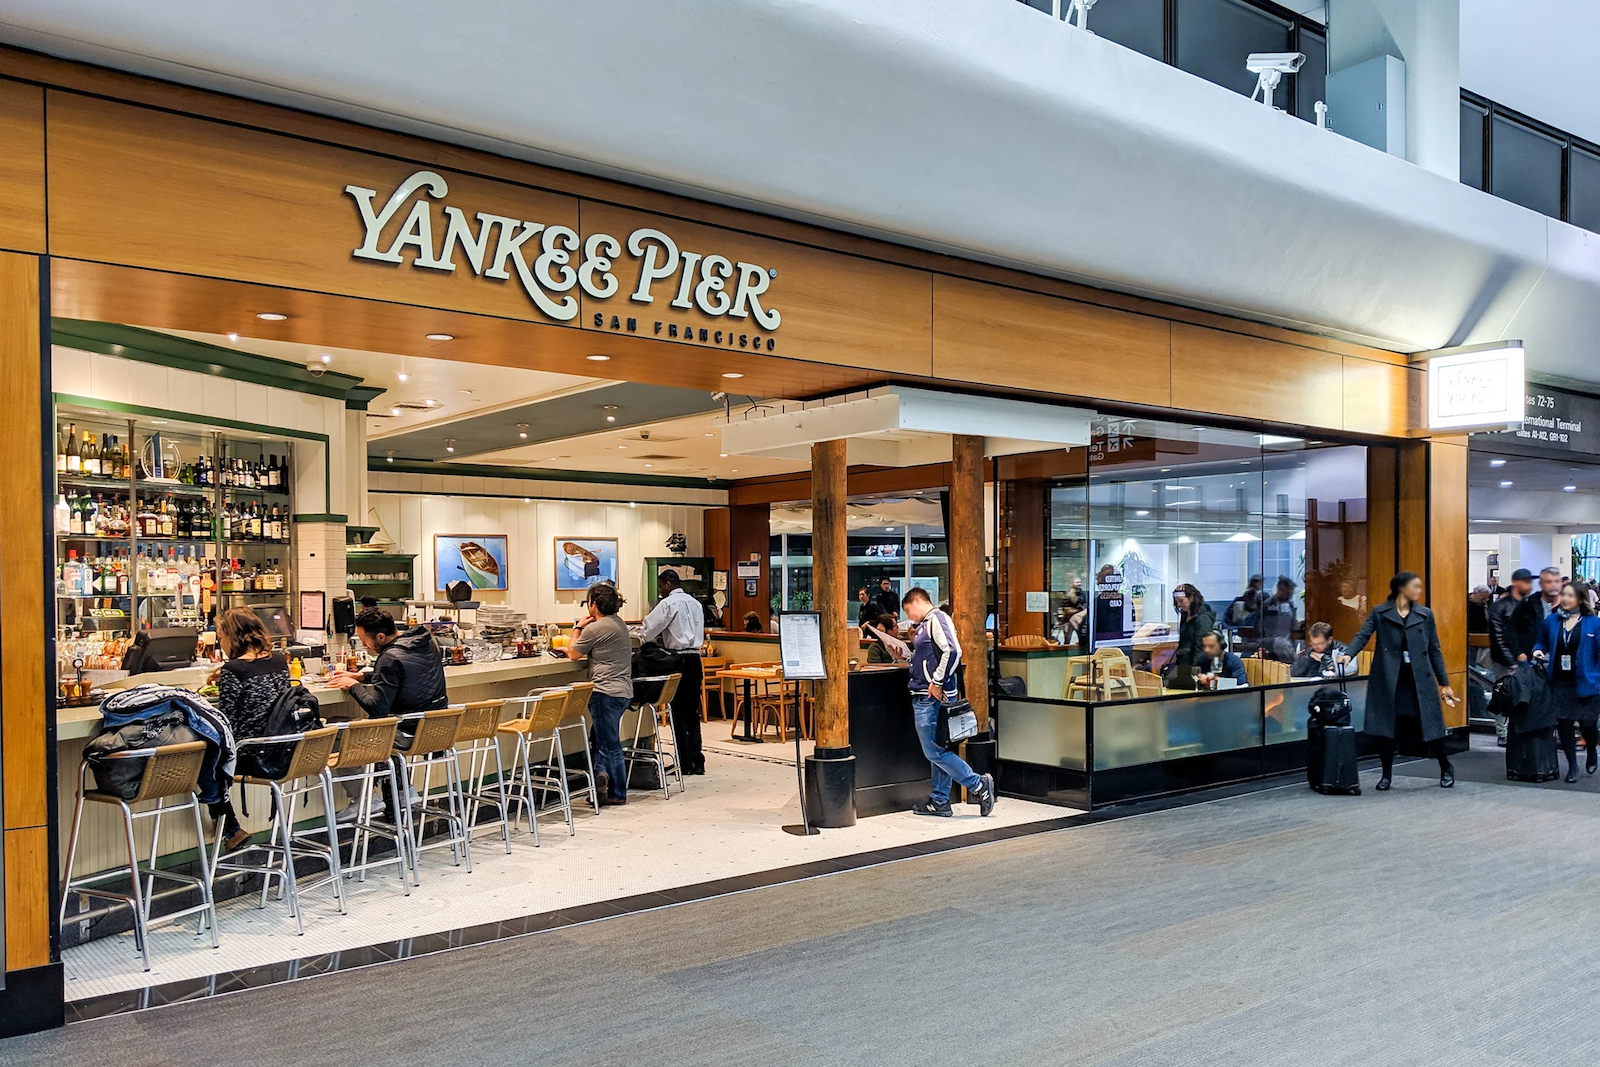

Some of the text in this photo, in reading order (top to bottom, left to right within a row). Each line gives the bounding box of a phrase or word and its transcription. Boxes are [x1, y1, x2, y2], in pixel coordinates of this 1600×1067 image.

[345, 170, 782, 331] YANKEE PIER
[594, 312, 776, 351] SAN FRANCISCO
[1537, 394, 1555, 409] 72-75
[1556, 417, 1582, 433] Terminal
